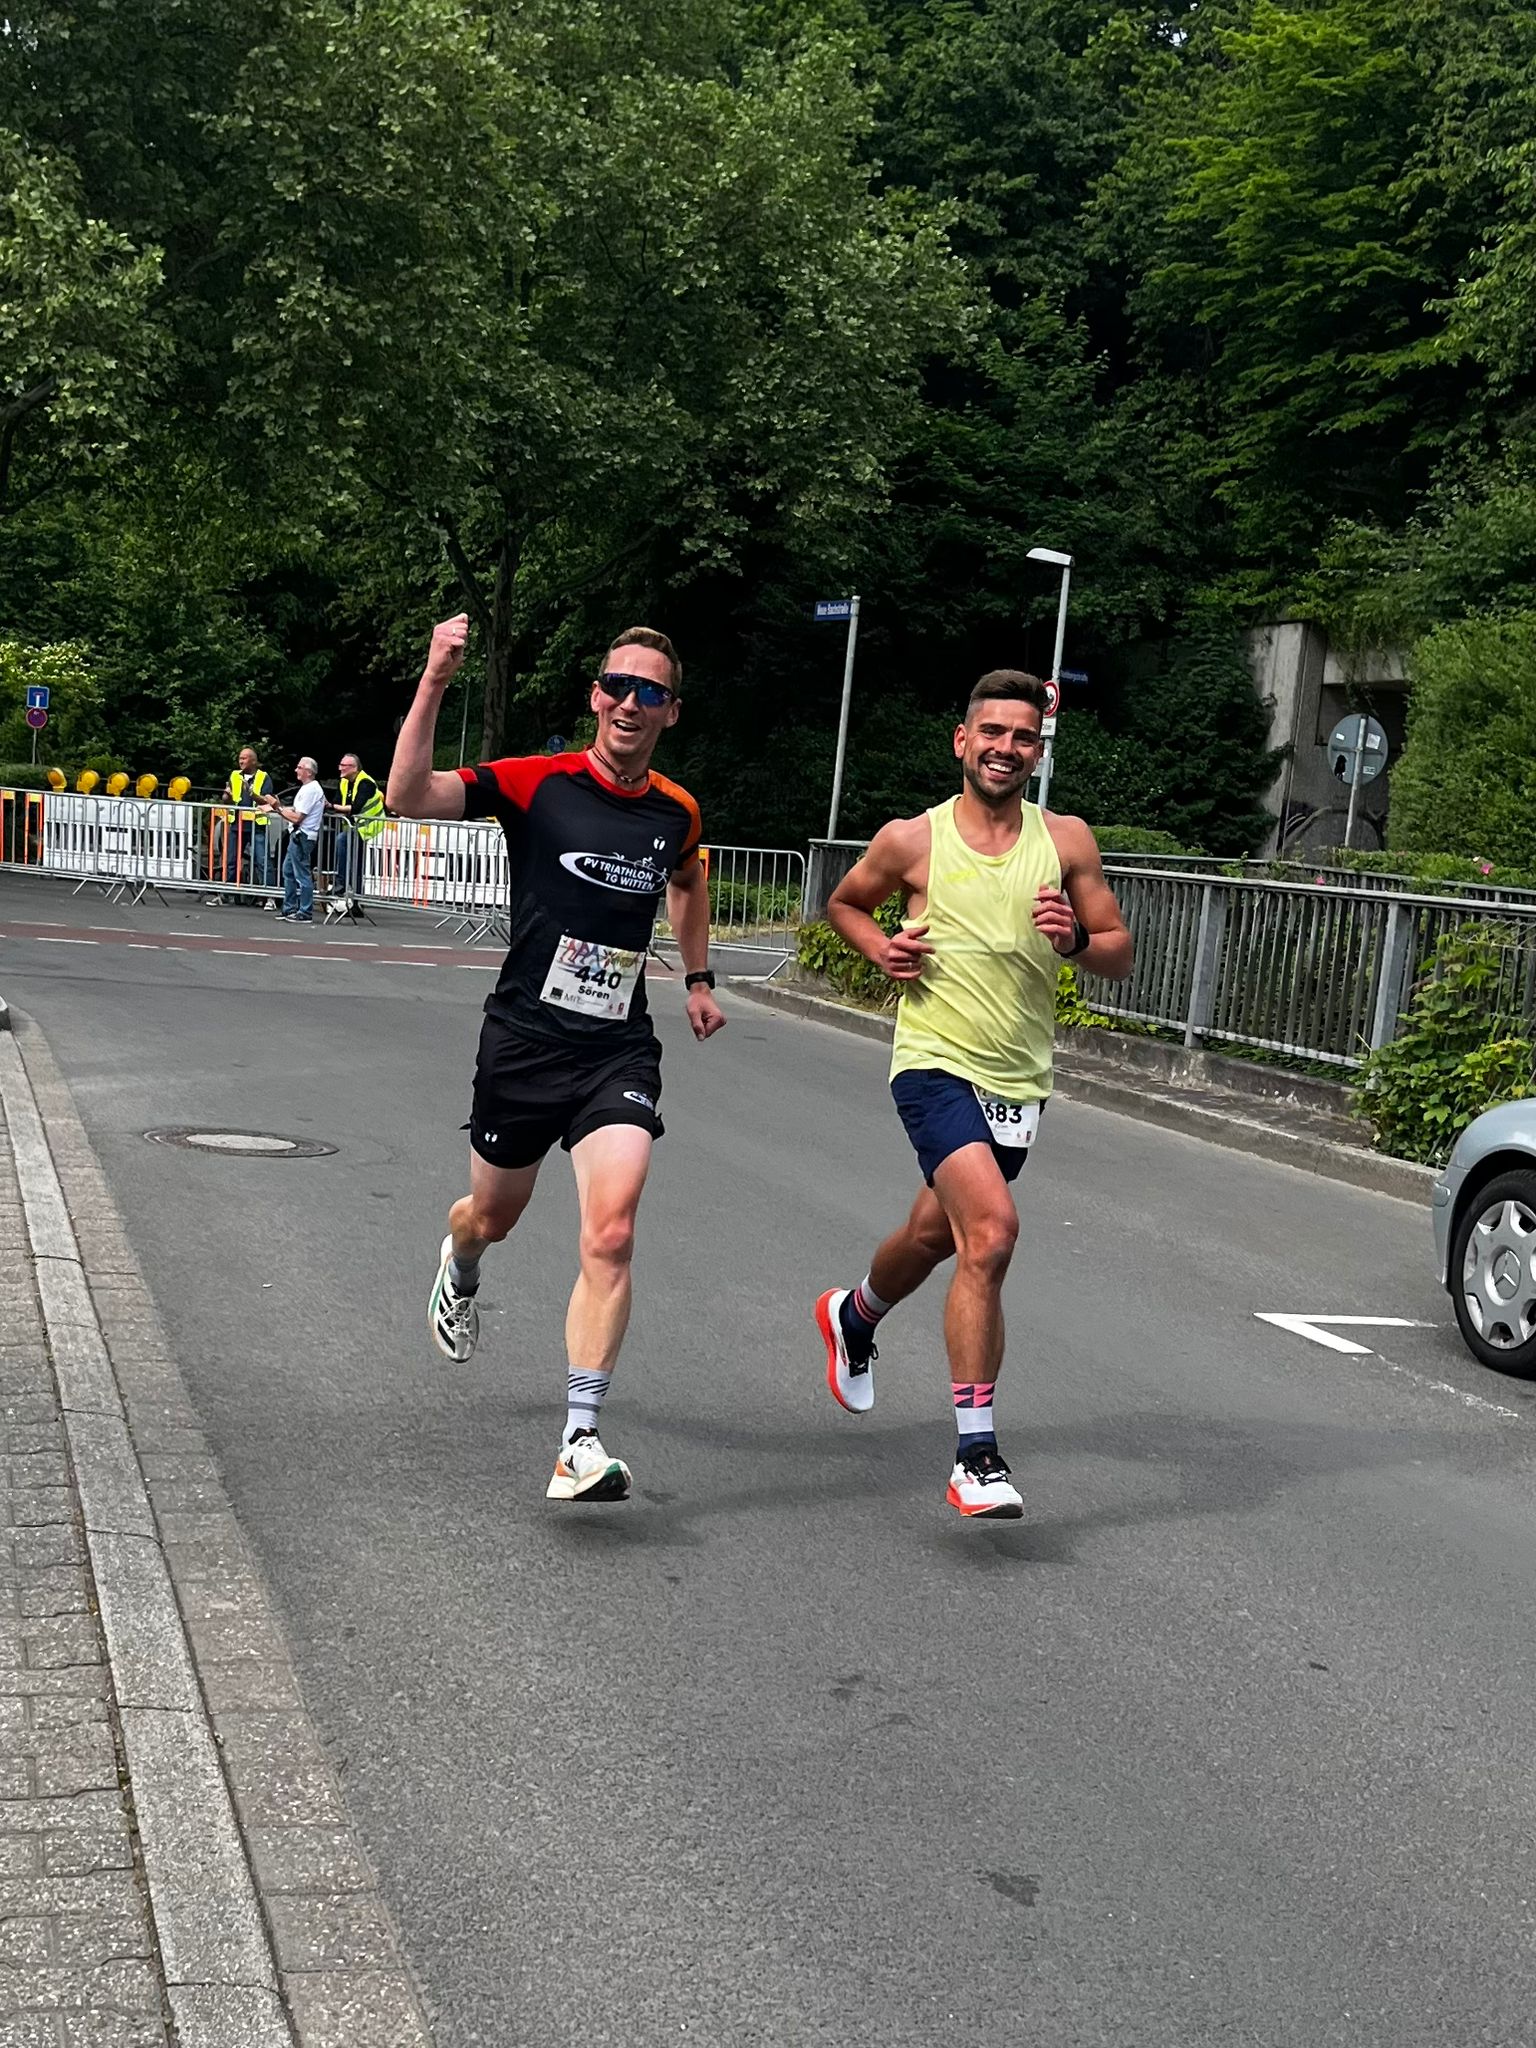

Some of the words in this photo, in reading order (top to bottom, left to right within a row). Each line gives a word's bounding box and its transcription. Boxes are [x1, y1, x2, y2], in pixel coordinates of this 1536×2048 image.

[583, 857, 599, 869] PV
[600, 861, 654, 882] TRIATHLON
[605, 872, 618, 883] TG
[620, 875, 656, 891] WITTEN
[574, 965, 622, 990] 440
[577, 984, 610, 1000] Sören
[985, 1102, 1023, 1124] 683
